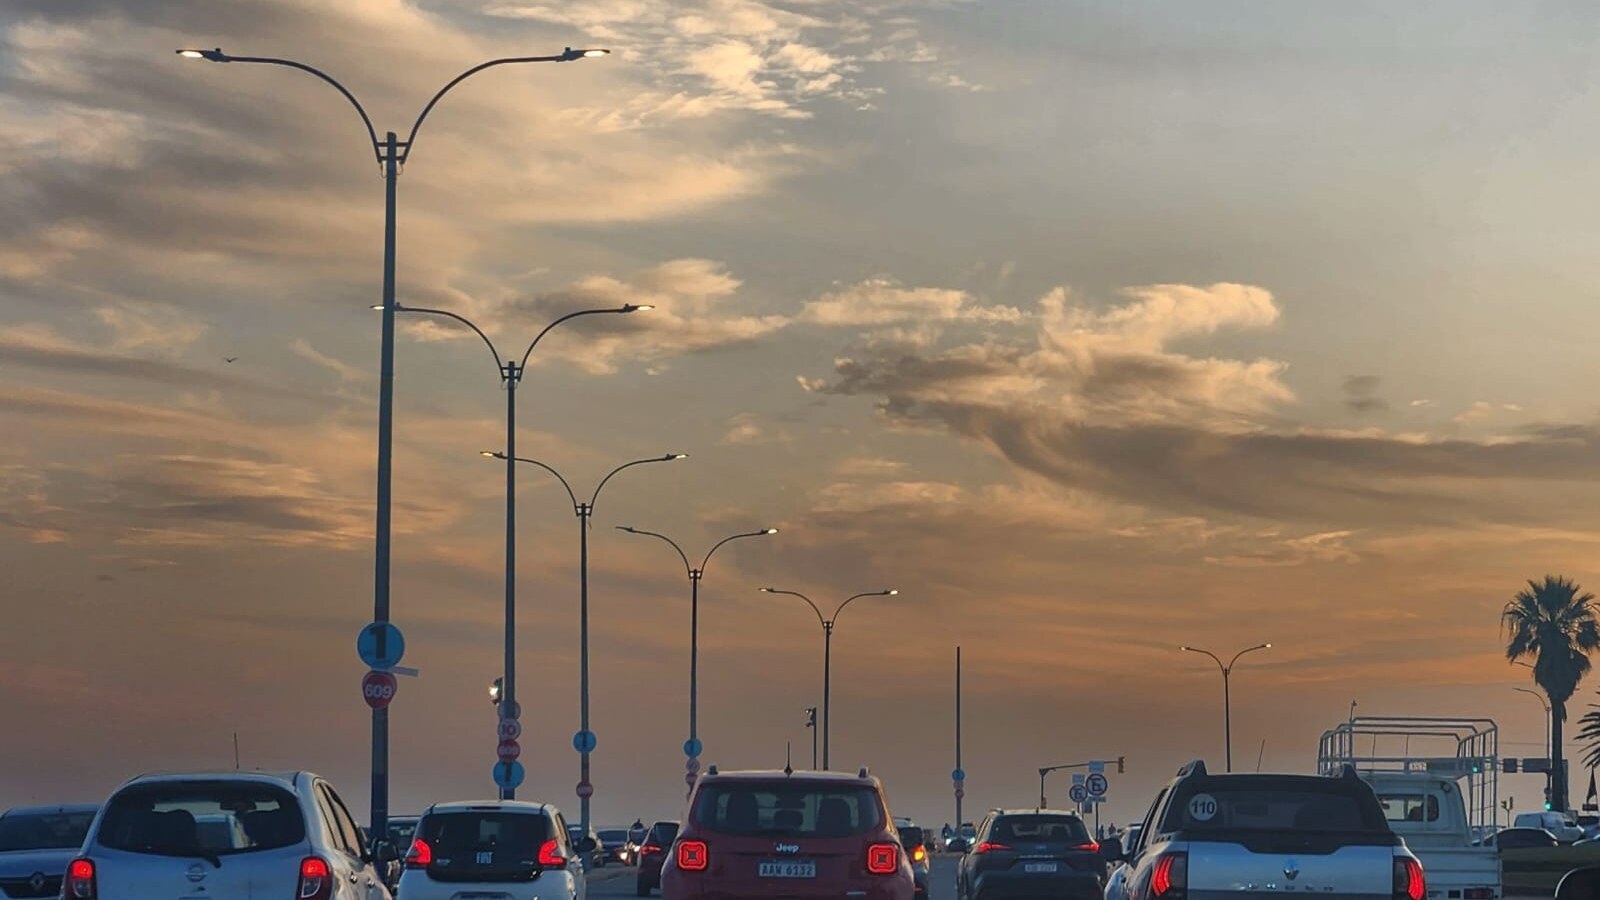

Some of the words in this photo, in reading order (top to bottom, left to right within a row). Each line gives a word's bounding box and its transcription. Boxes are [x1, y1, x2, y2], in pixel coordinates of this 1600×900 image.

[365, 684, 393, 699] 609
[1191, 800, 1215, 815] 110
[776, 842, 800, 853] Jeep
